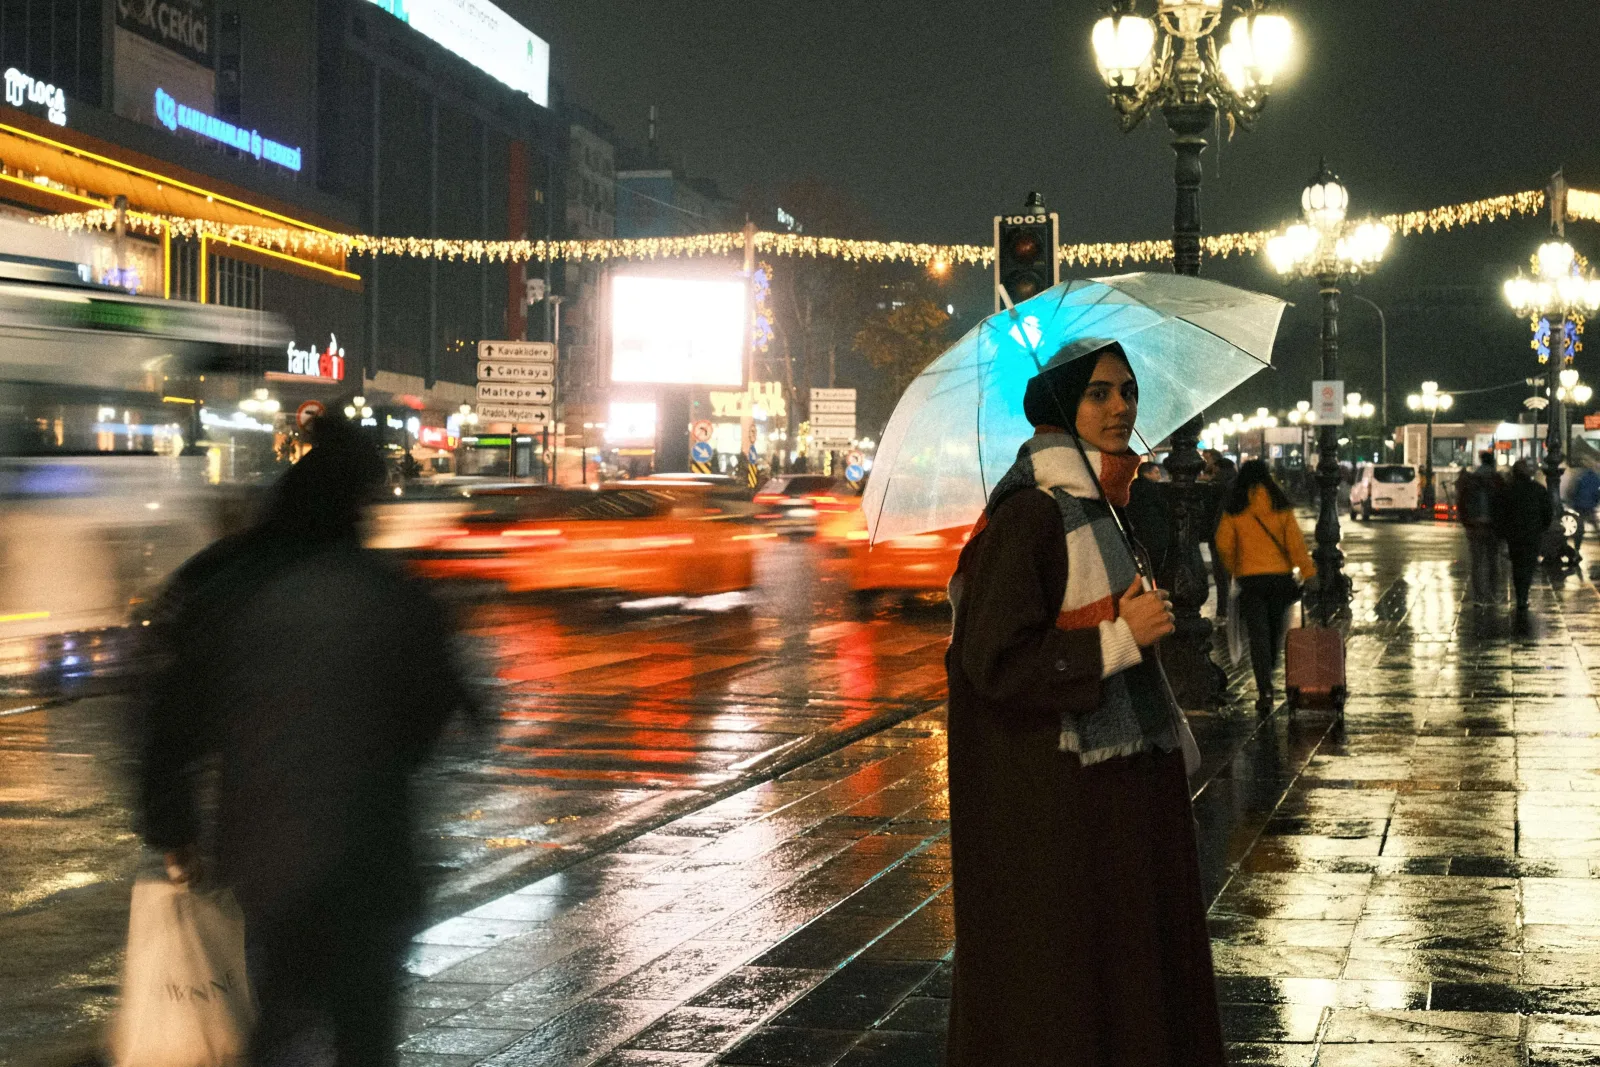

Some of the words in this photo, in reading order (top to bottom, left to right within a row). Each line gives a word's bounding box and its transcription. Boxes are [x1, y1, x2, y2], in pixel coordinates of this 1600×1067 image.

[1005, 214, 1047, 225] 1003
[497, 366, 548, 378] Çankaya
[481, 387, 531, 399] Maltepe
